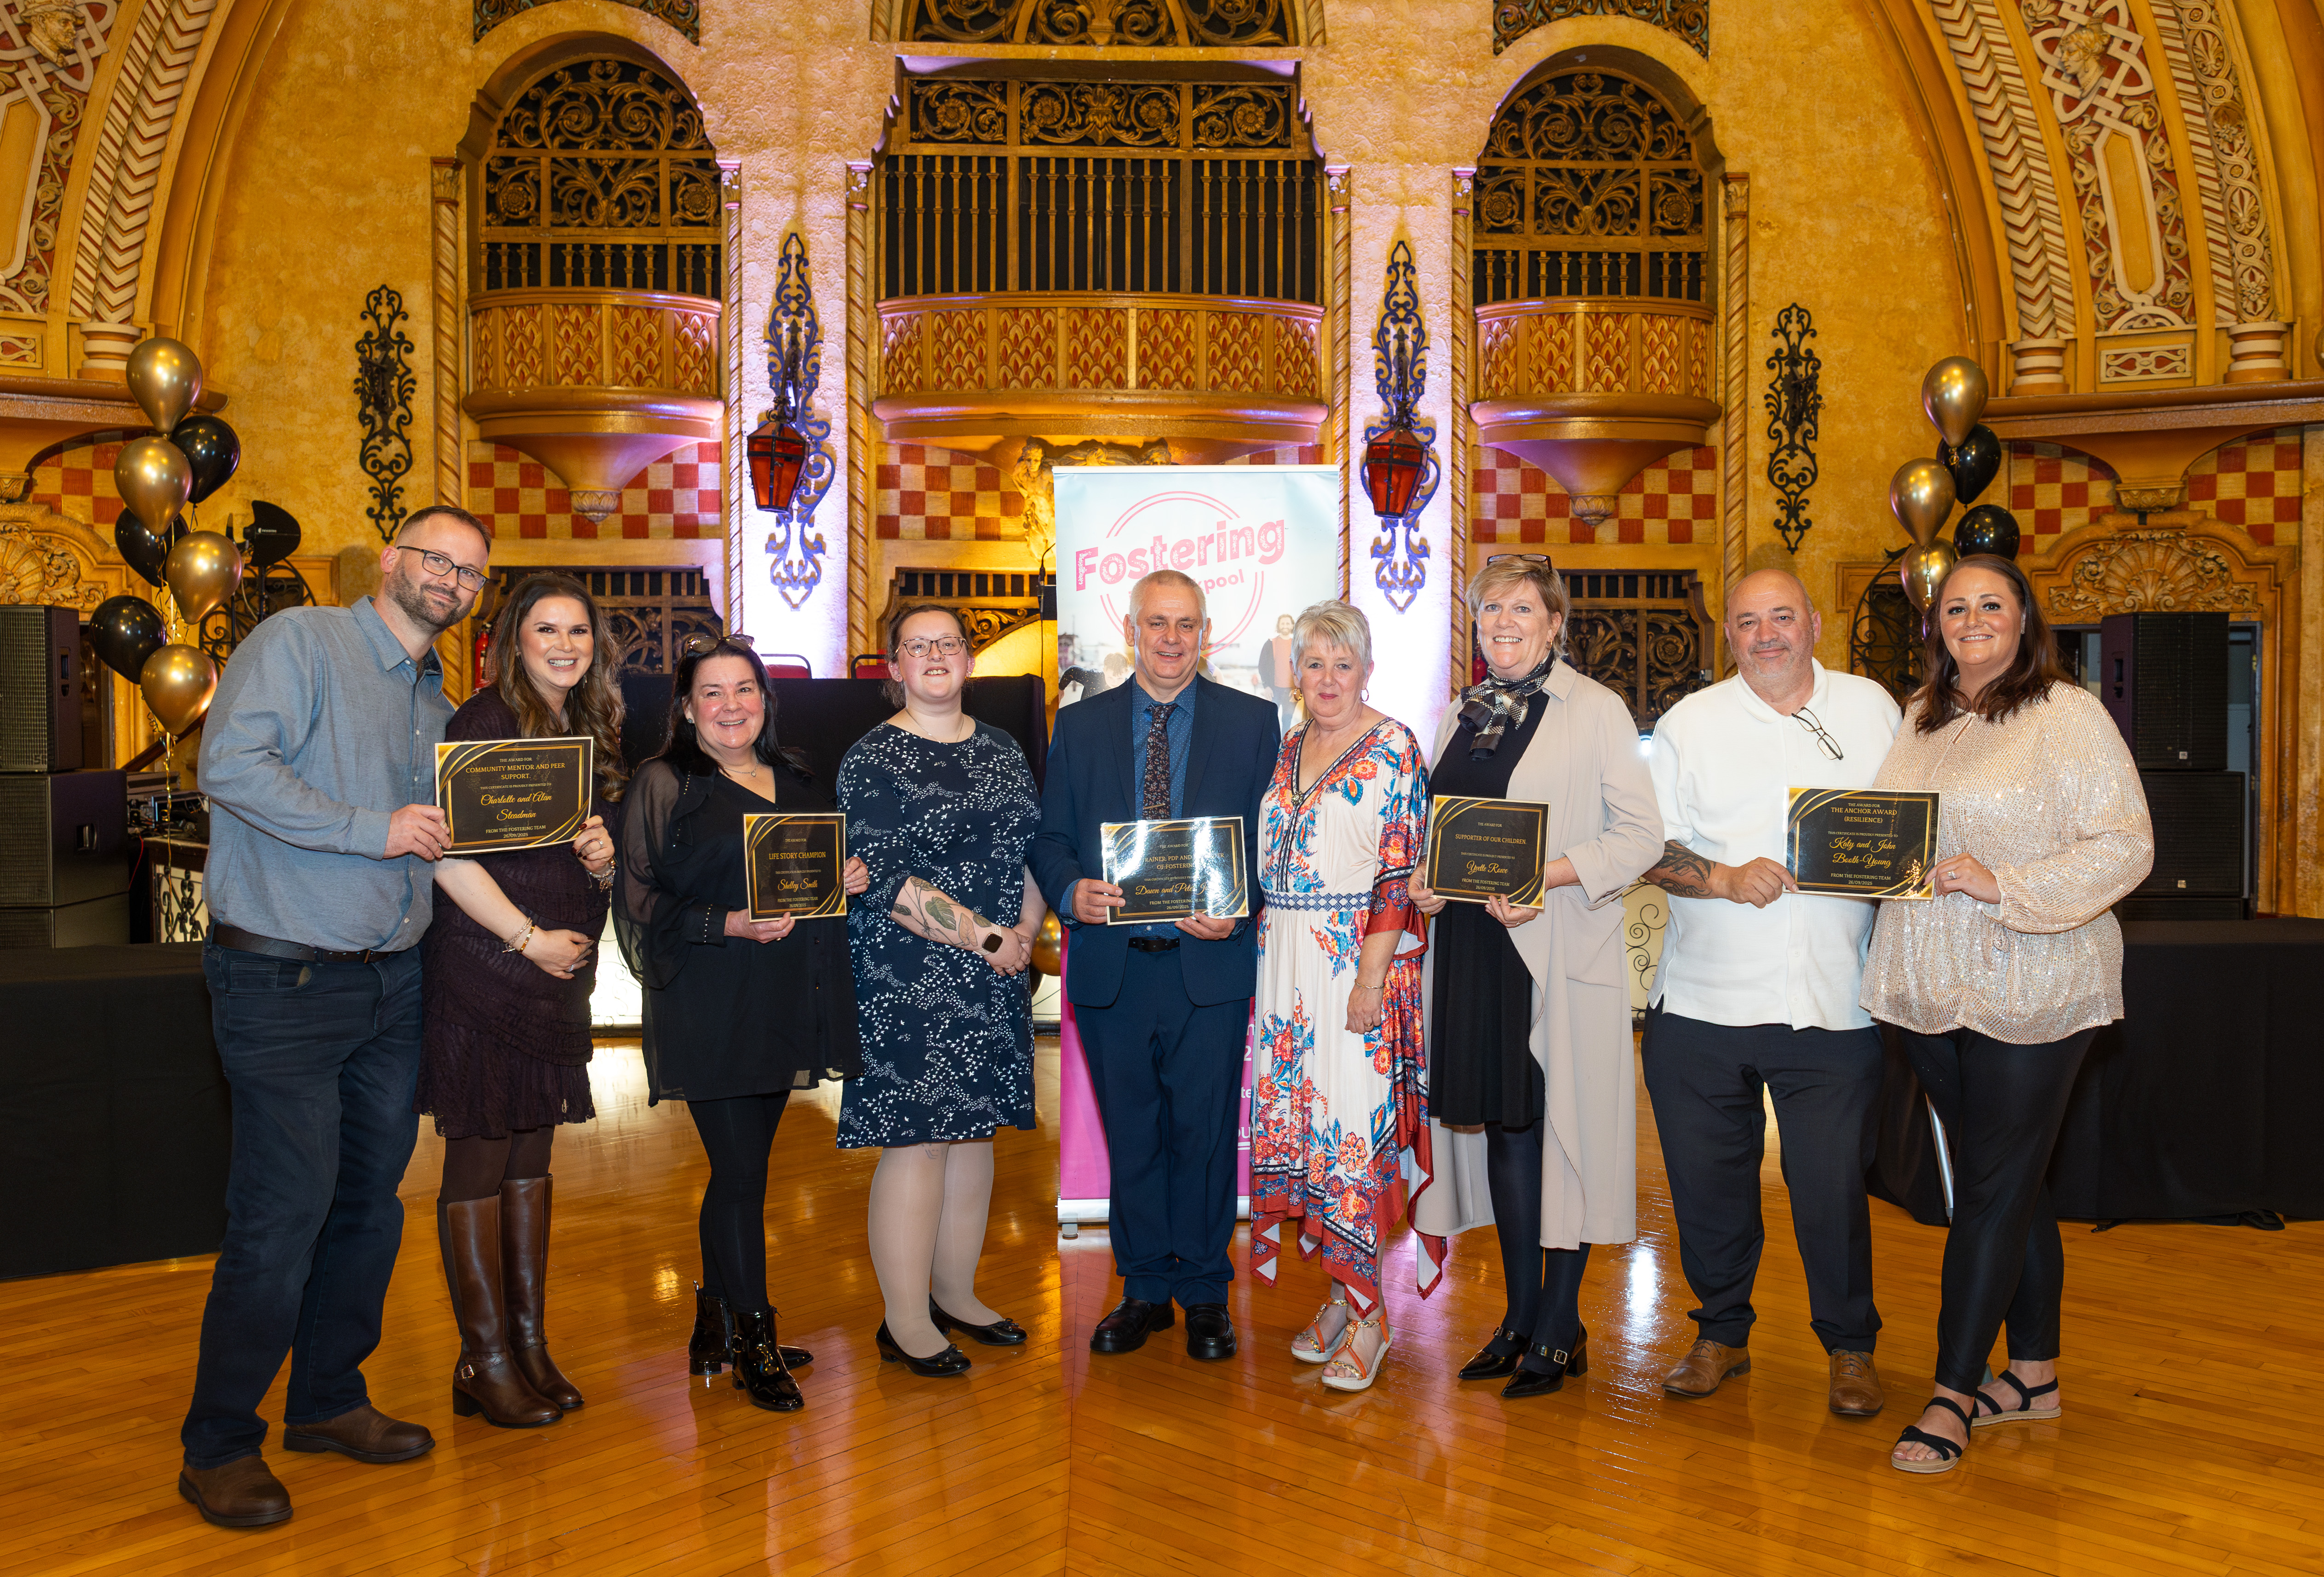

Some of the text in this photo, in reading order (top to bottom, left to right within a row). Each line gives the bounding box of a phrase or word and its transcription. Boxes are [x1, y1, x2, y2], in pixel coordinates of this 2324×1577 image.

[1076, 519, 1285, 591] Fostering
[481, 791, 552, 806] Charlotte and Alan
[497, 809, 537, 821] Steadman
[1829, 837, 1896, 853] Katy and John
[1467, 860, 1509, 875] Yvette Rowe
[1832, 853, 1892, 869] Booth-Young
[778, 878, 818, 892] Shelley Smith
[1135, 885, 1159, 895] Dawn
[1161, 885, 1175, 894] and
[1175, 883, 1193, 893] Pete
